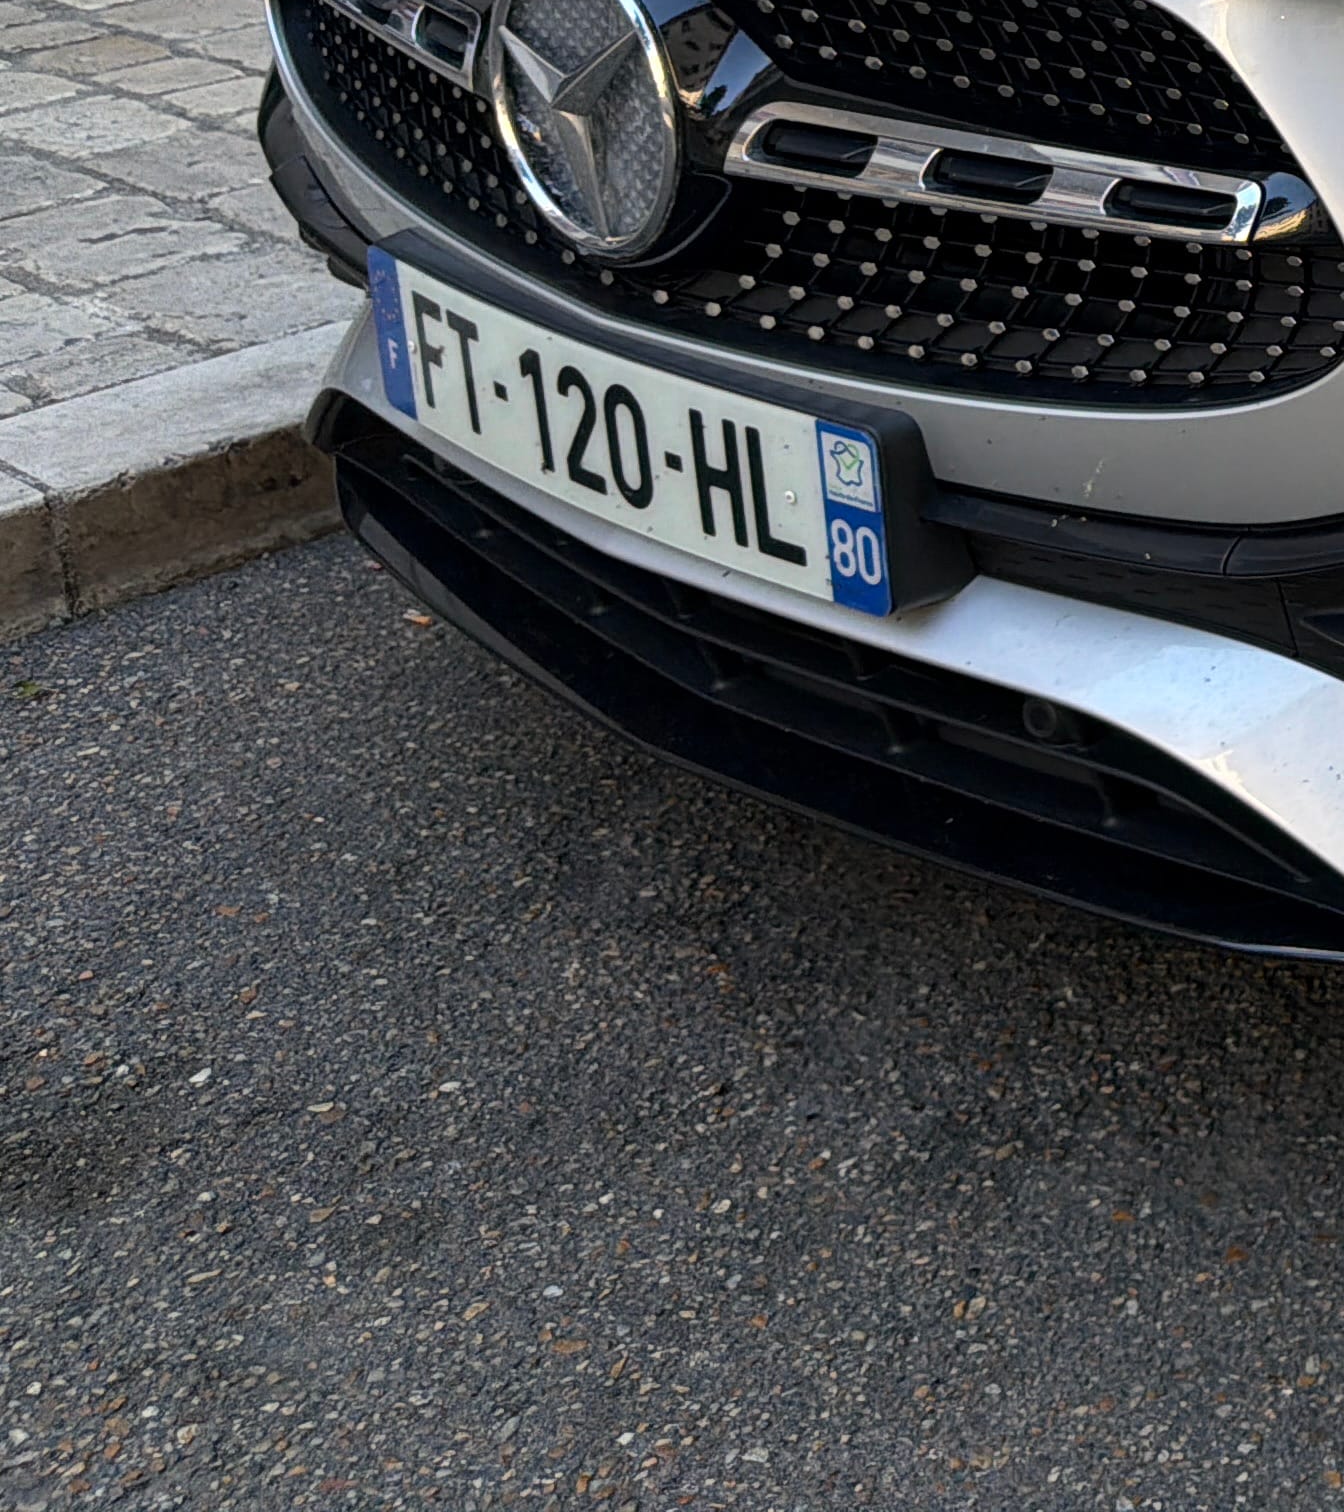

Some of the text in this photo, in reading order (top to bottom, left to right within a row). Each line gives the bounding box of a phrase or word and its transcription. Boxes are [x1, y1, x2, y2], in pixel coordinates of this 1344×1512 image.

[387, 337, 399, 370] F
[411, 289, 807, 568] FT-120-HL
[831, 518, 882, 586] 80
